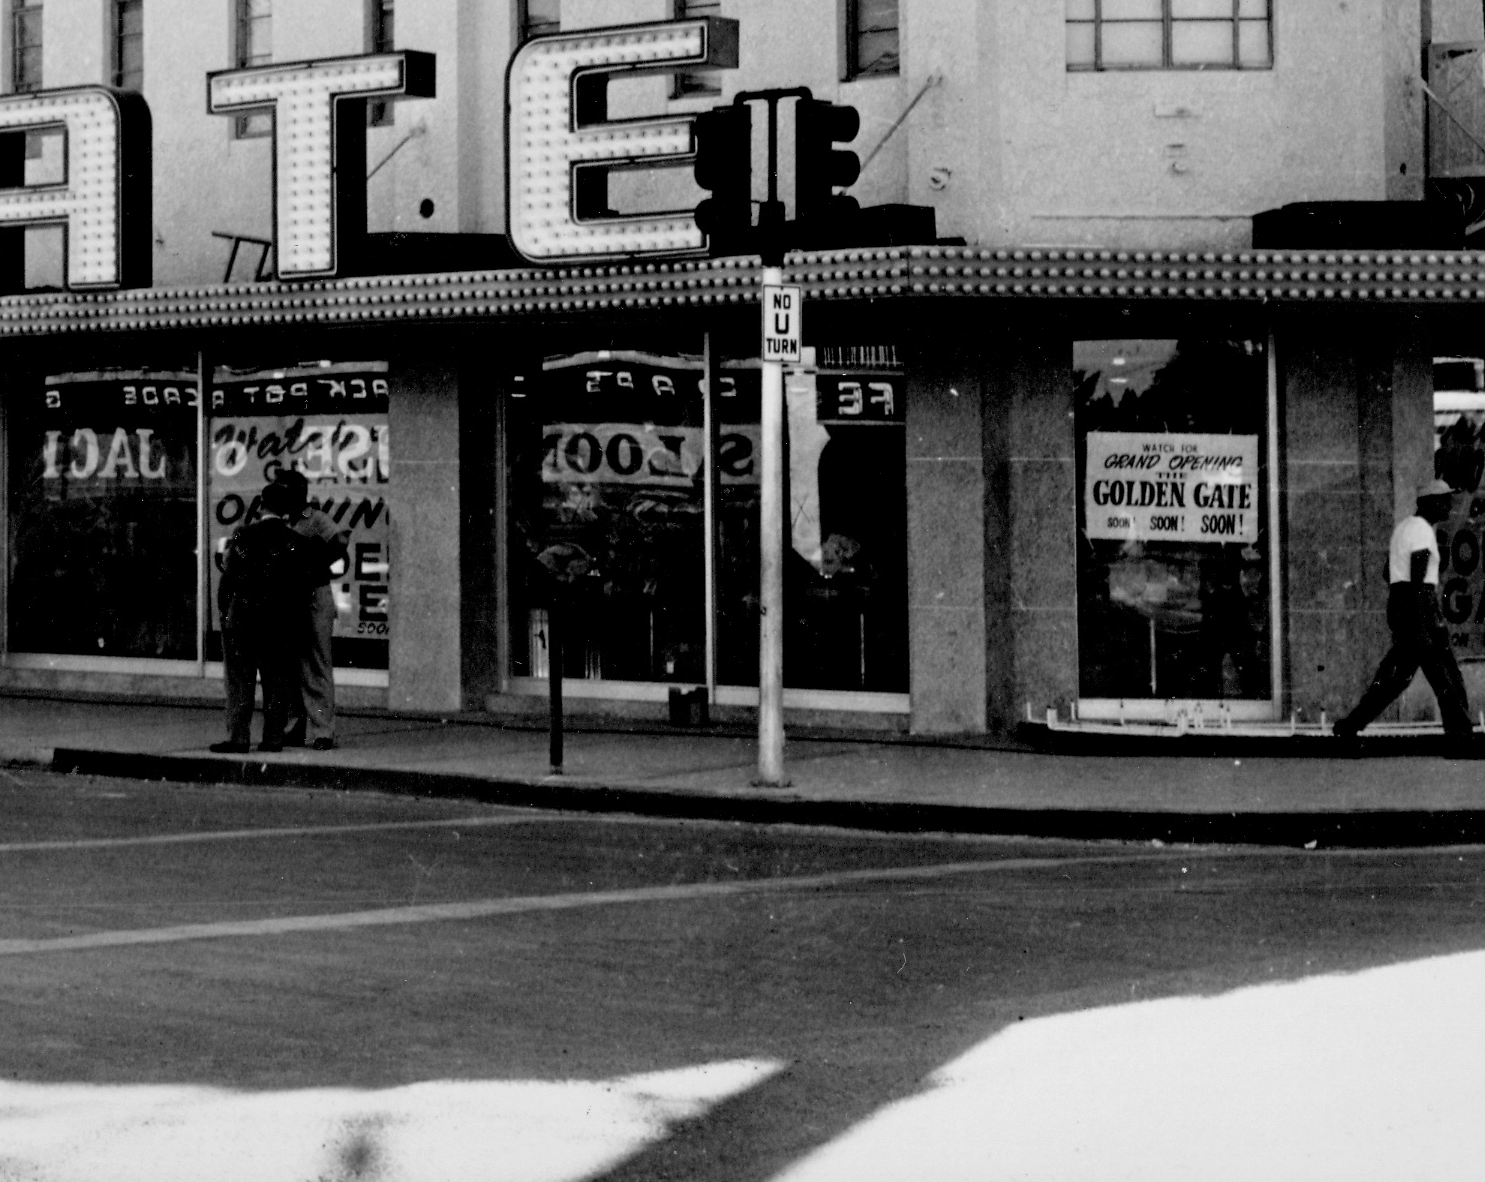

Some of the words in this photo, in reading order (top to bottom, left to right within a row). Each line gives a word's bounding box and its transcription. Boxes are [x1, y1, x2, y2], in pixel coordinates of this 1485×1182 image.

[773, 294, 791, 309] NO
[775, 313, 789, 335] U
[766, 338, 797, 355] TURN
[1142, 444, 1175, 453] WATCH
[1181, 445, 1198, 453] FOR
[1104, 454, 1161, 469] GRAND
[1093, 480, 1185, 508] GOLDEN
[1193, 481, 1252, 510] GATE
[1150, 515, 1185, 532] SOON!
[1201, 514, 1244, 536] SOON!
